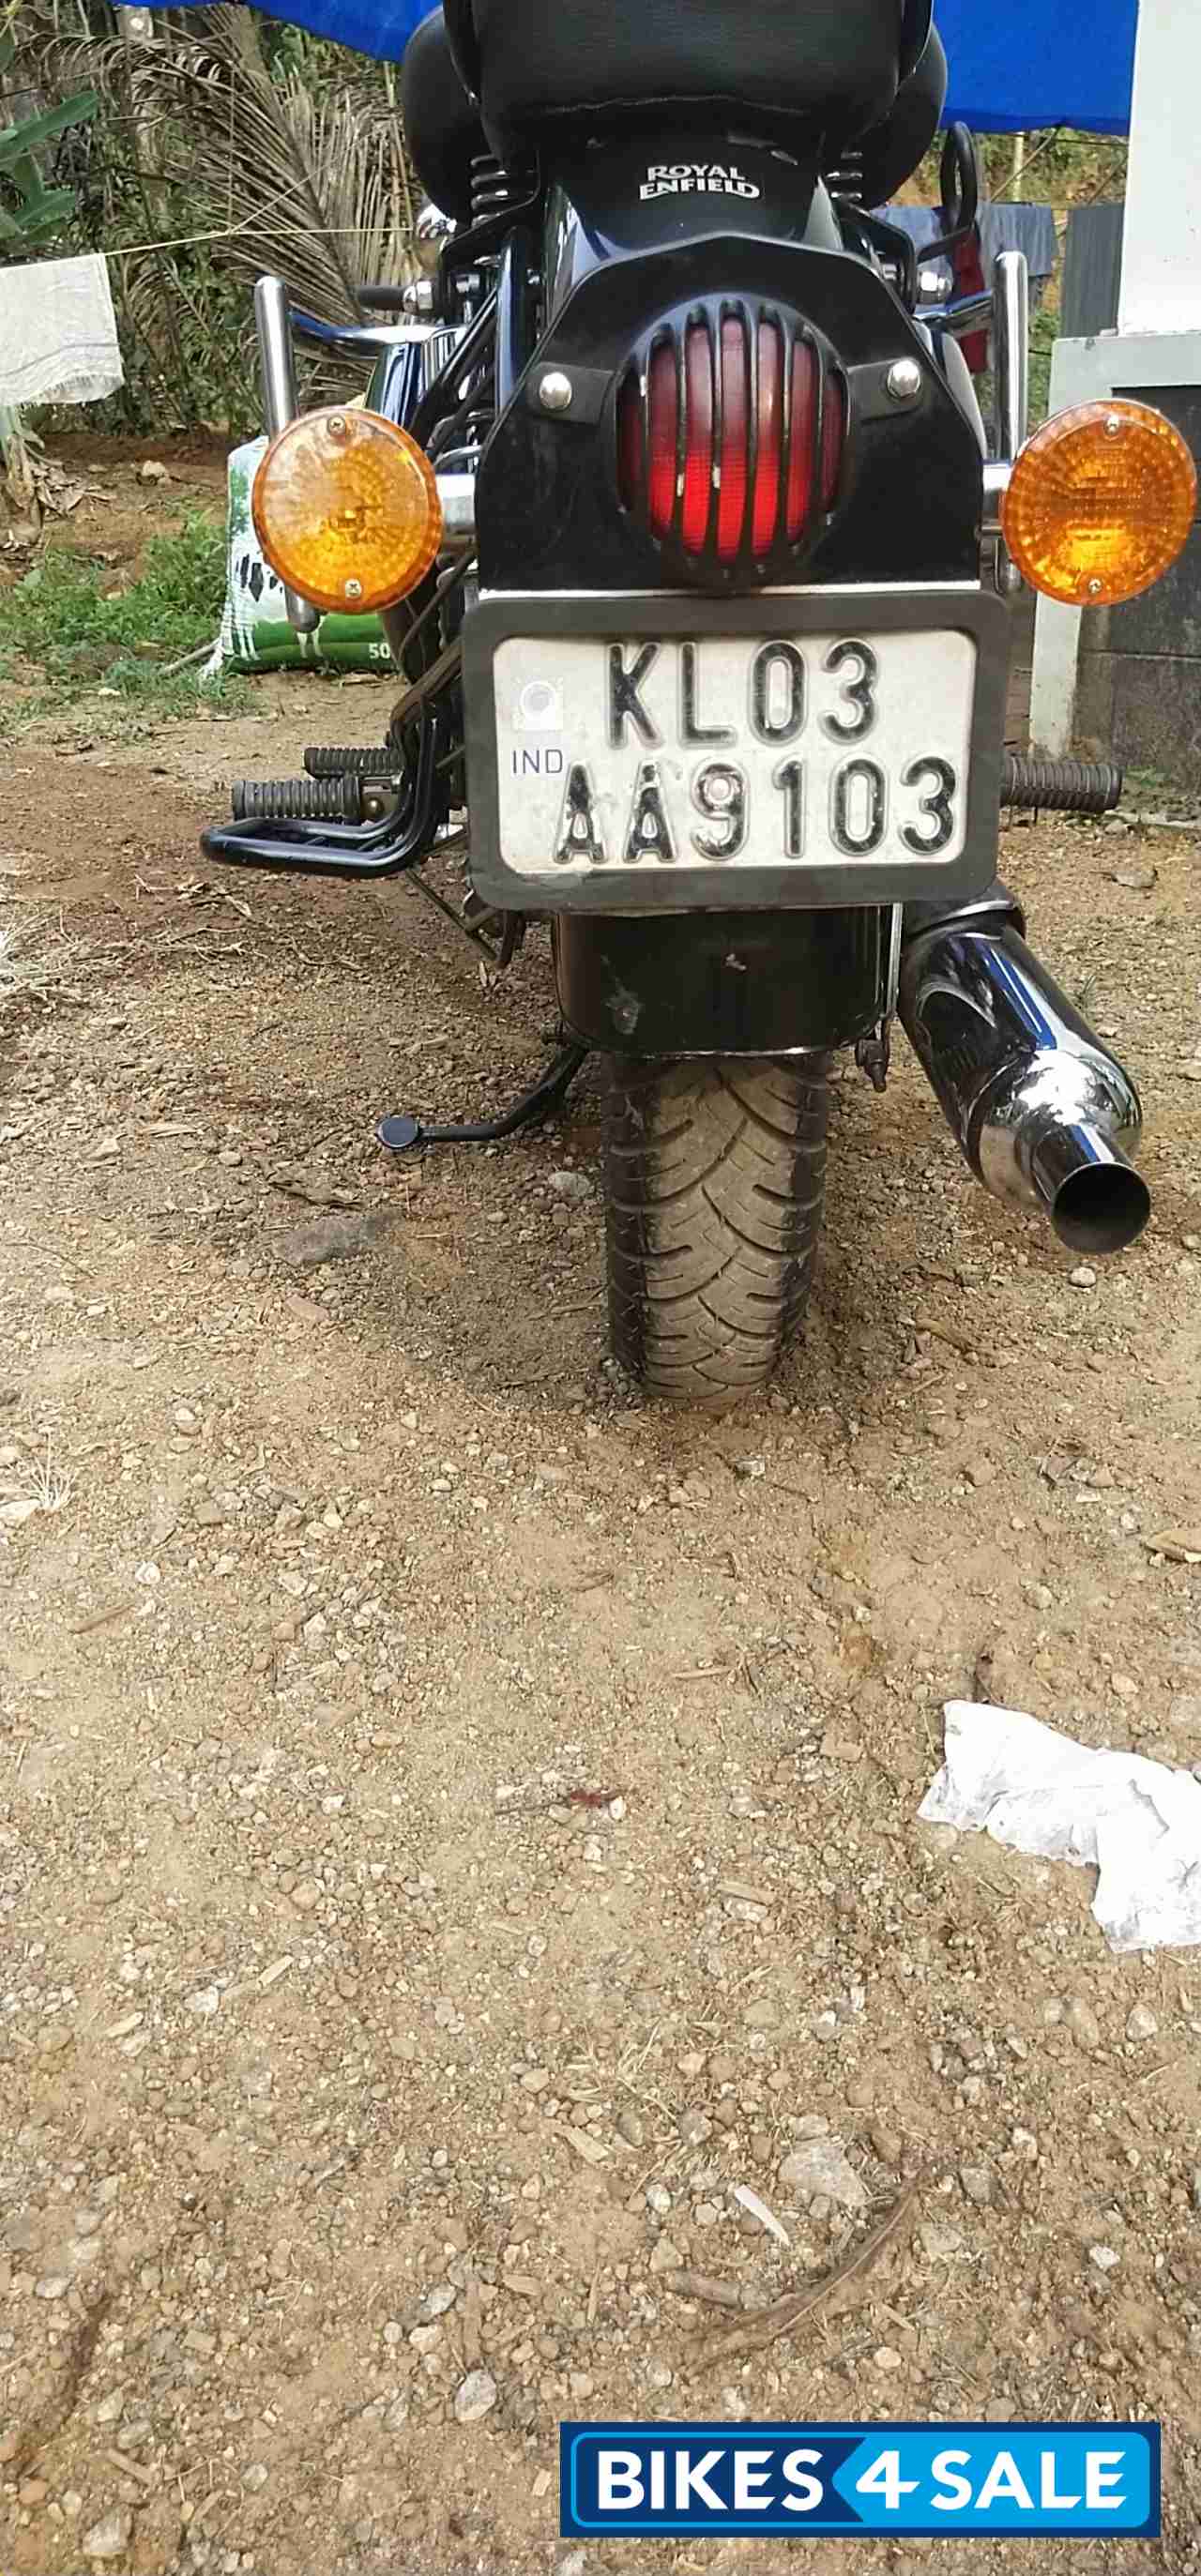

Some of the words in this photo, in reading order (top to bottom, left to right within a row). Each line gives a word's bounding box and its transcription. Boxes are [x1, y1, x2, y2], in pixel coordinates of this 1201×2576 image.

[647, 164, 745, 181] ROYAL
[639, 178, 760, 200] ENFIELD
[606, 639, 879, 748] KL03
[512, 749, 563, 774] IND
[553, 754, 957, 863] AA9103
